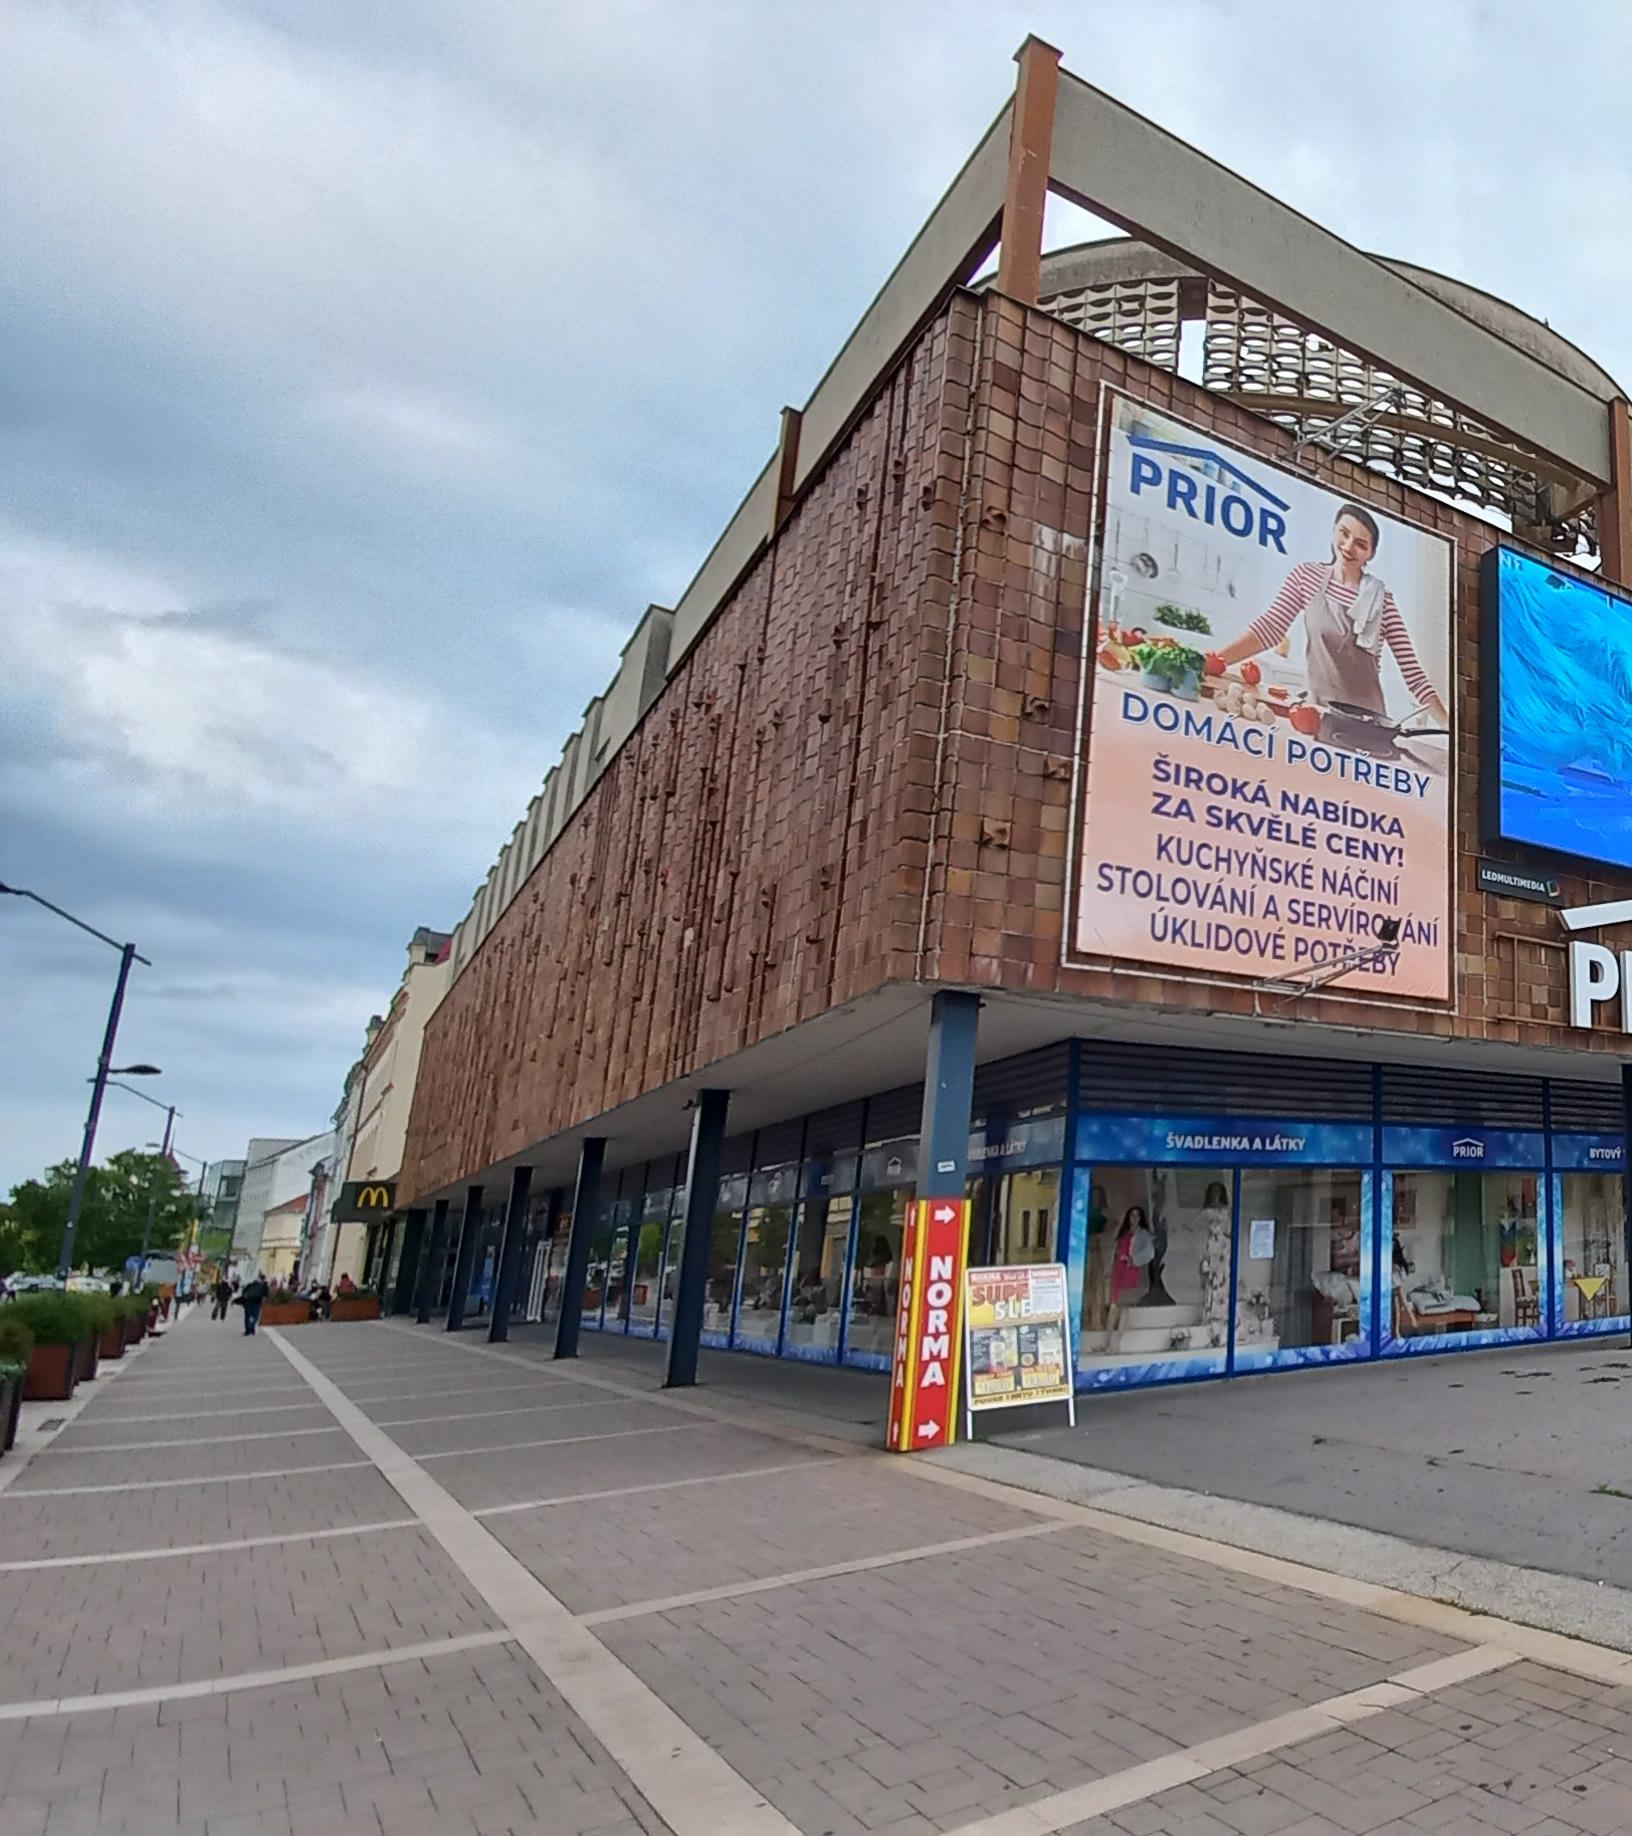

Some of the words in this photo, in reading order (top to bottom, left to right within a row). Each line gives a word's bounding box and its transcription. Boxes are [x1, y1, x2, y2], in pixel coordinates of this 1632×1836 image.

[1129, 451, 1287, 555] PRIOR
[1121, 692, 1276, 759] DOMÁCÍ
[1286, 738, 1432, 799] POTŘEBY
[1150, 791, 1195, 823] ZA
[1204, 805, 1318, 850] SKVĚLÉ
[1325, 833, 1405, 868] CENY!
[1151, 752, 1271, 808] ŠIROKÁ
[1280, 789, 1405, 839] NABÍDKA
[1096, 862, 1258, 918] STOLOVÁNÍ
[1262, 895, 1281, 922] A
[1286, 898, 1440, 947] SERVÍROÁNÍ
[1155, 832, 1315, 891] KUCHYŇSKÉ
[1321, 863, 1400, 906] NÁČINÍ
[1481, 869, 1545, 893] LEDMULTIMEDIA
[1149, 907, 1287, 961] ÚKLIDOVÉ
[1166, 1131, 1250, 1150] ŠVADLENKA
[1252, 1137, 1263, 1150] A
[1265, 1133, 1306, 1151] LÁTKY
[1452, 1145, 1484, 1159] PRIOR
[1589, 1146, 1622, 1160] BYTOVÝ
[895, 1257, 913, 1388] NORMA
[920, 1255, 953, 1388] NORMA
